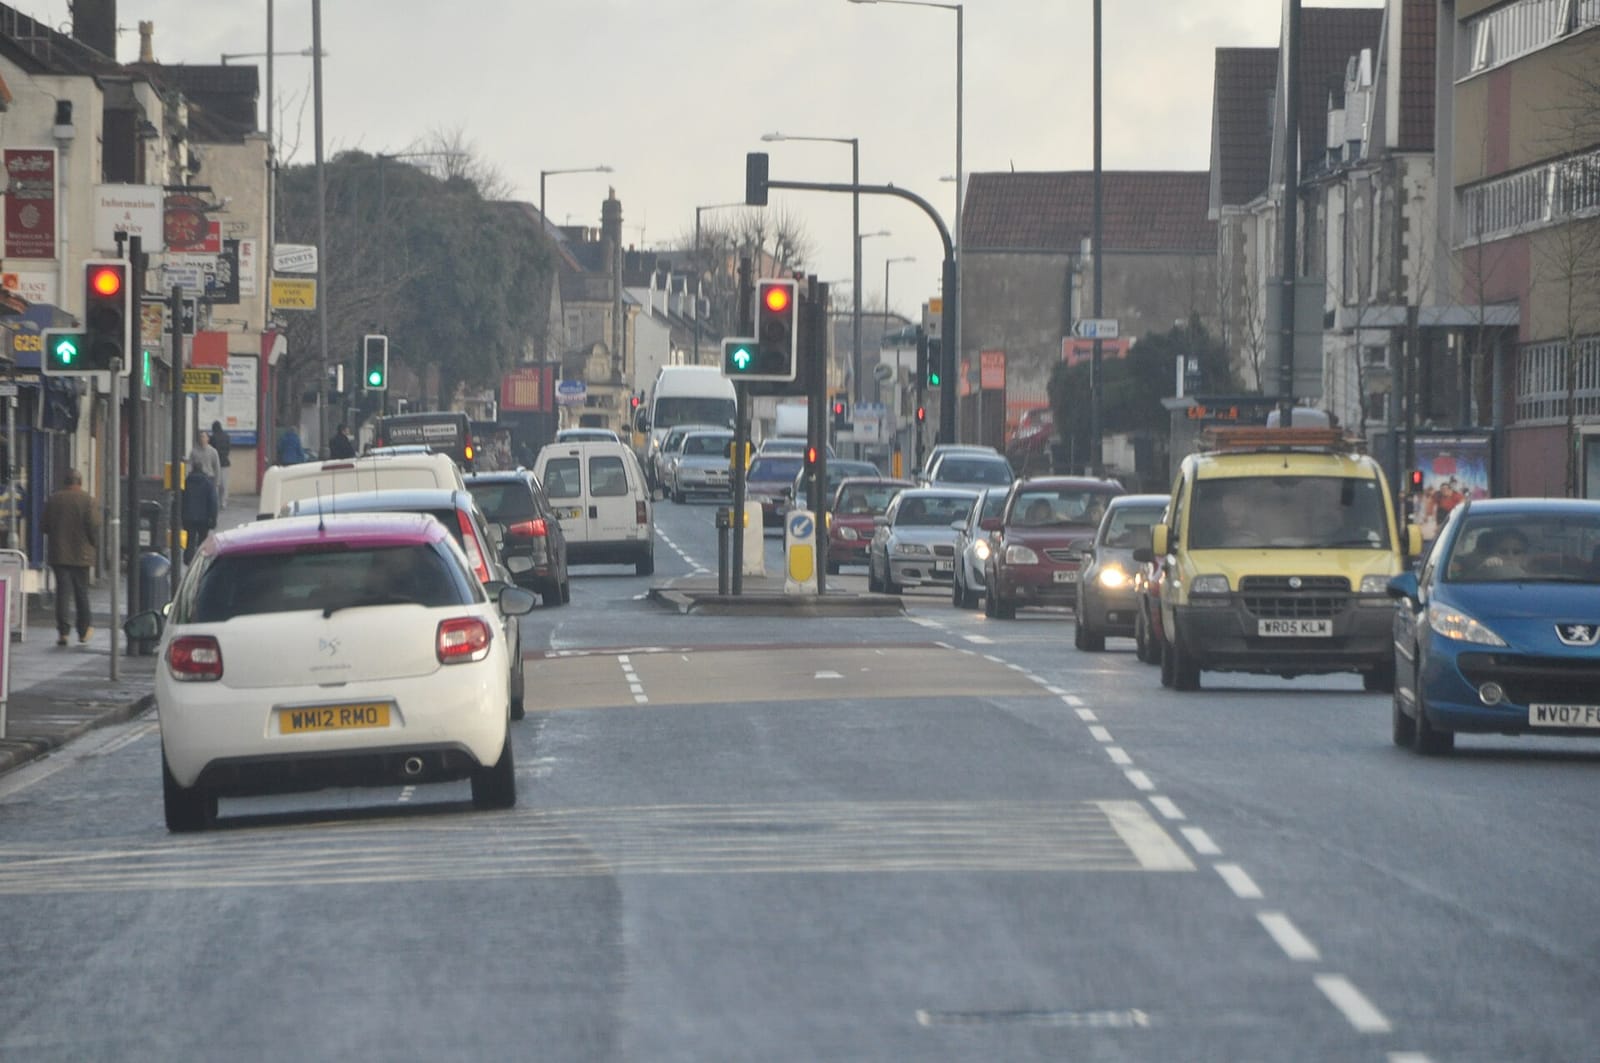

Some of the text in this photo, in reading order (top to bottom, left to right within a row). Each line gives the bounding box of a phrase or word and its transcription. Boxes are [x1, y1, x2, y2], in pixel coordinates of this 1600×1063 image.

[1264, 621, 1298, 633] WR05
[291, 710, 335, 729] WM12
[1536, 705, 1581, 723] WV07
